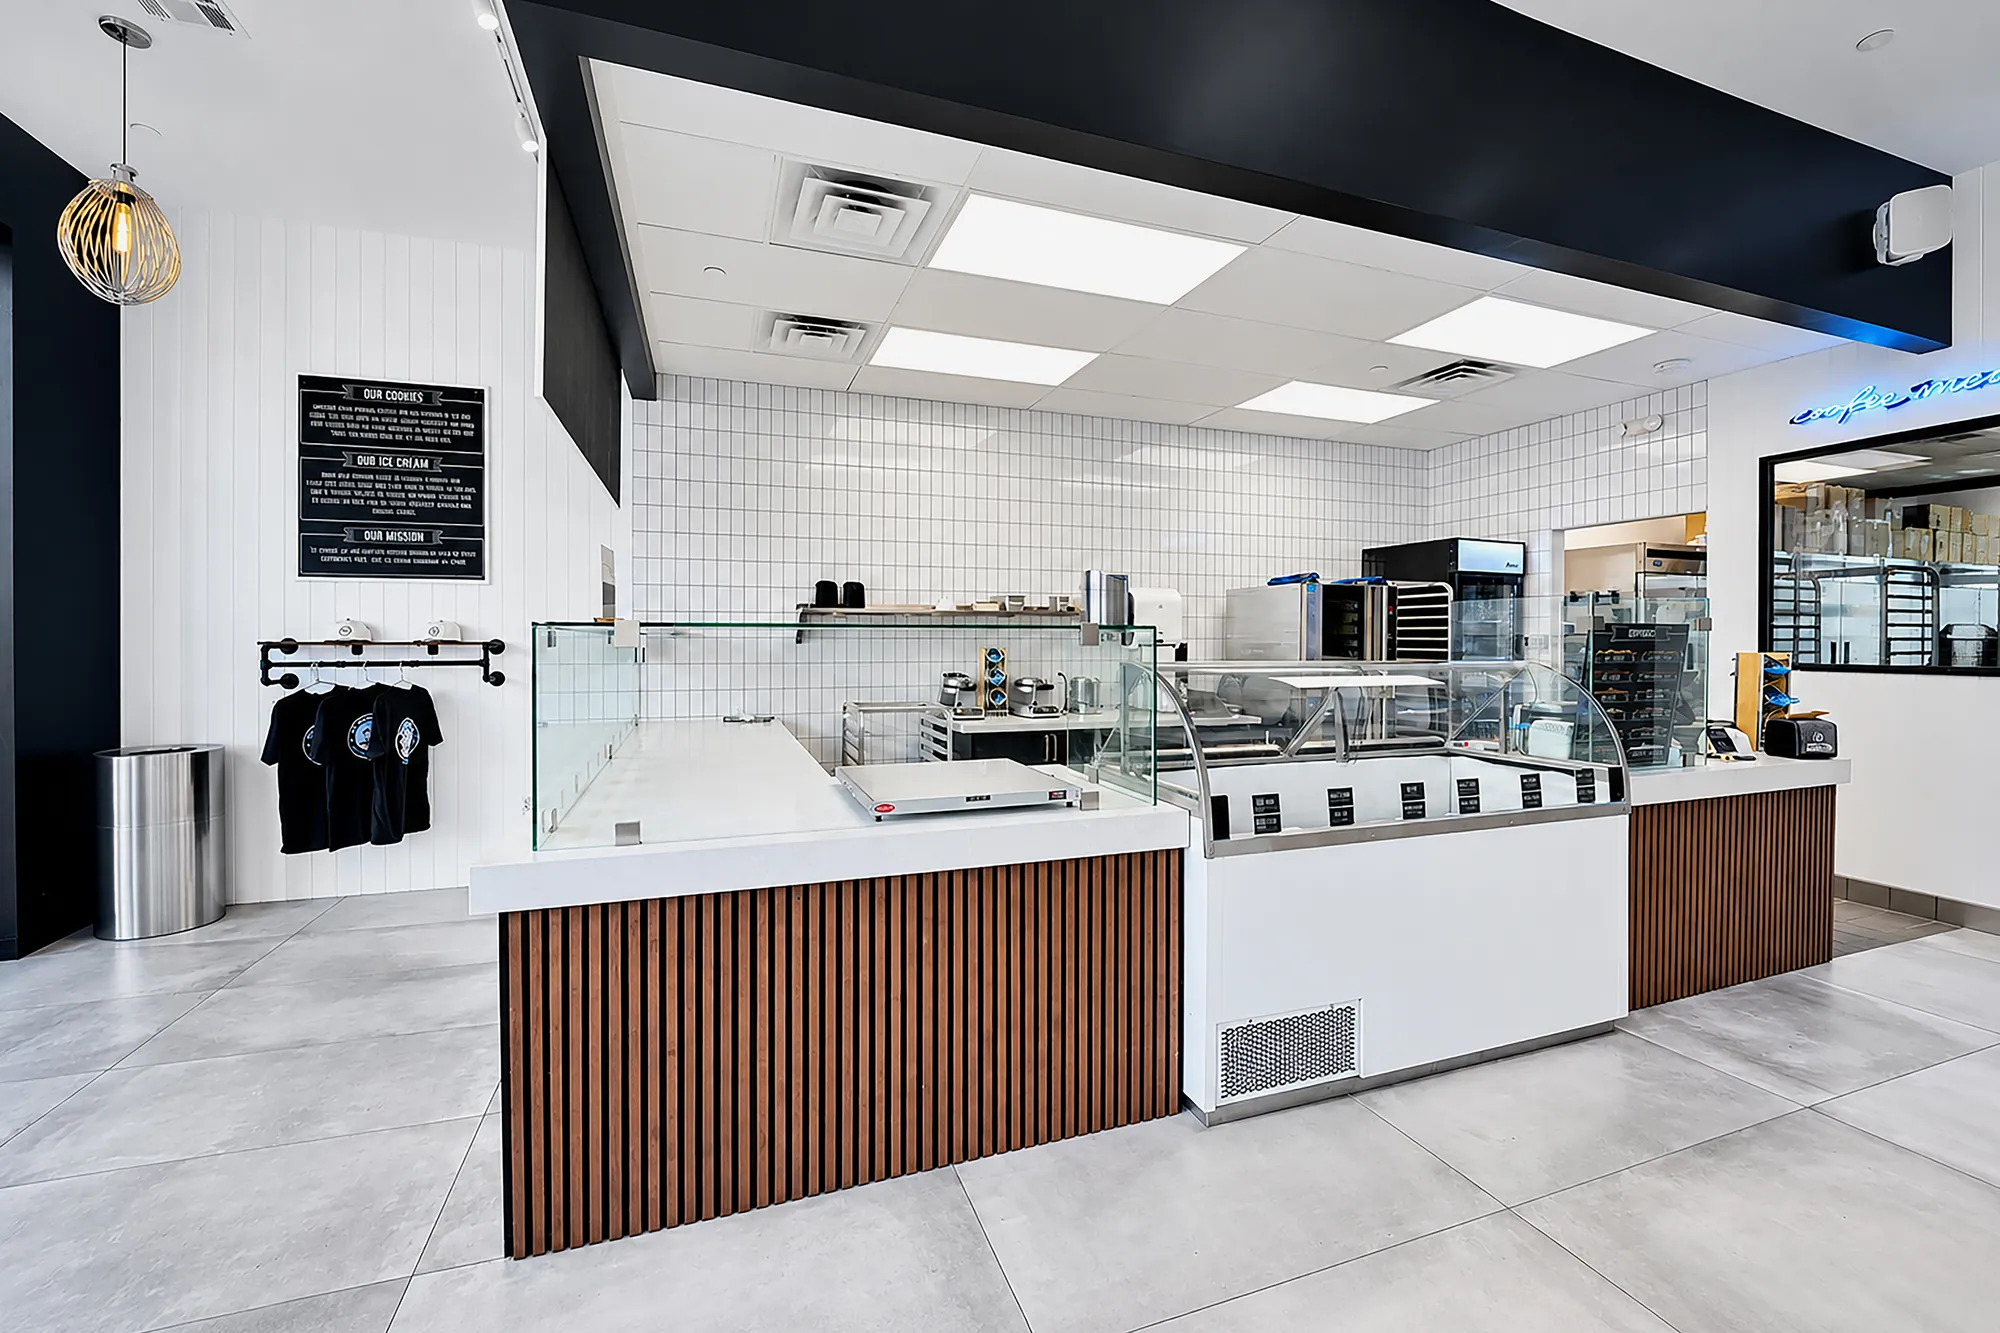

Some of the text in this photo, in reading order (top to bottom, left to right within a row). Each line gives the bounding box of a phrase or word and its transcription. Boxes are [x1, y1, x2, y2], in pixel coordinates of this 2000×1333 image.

[363, 388, 424, 403] OUR COOKIES
[357, 455, 429, 469] OUR ICE CREAM
[364, 530, 424, 542] OUR MISSION
